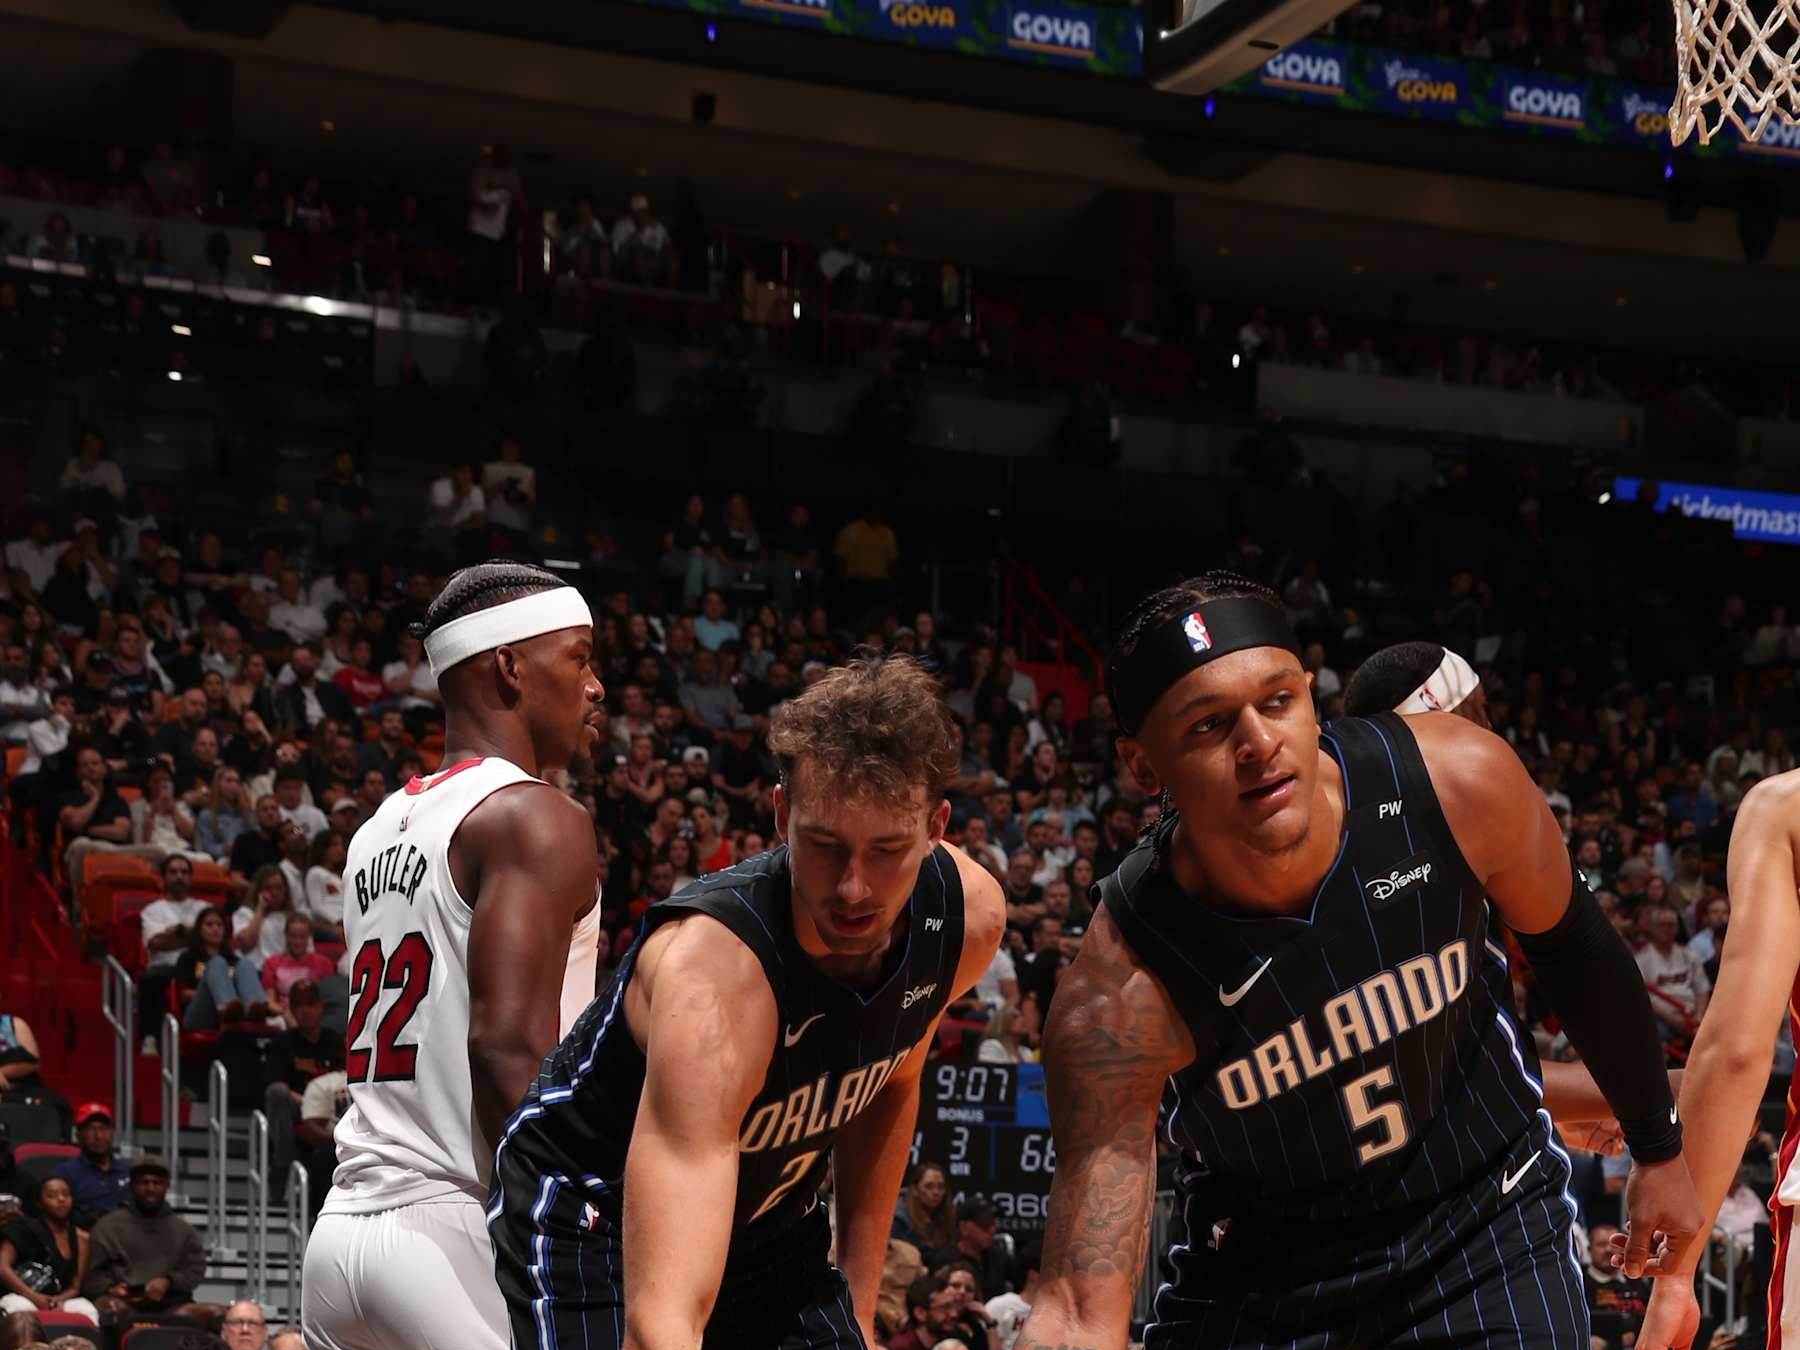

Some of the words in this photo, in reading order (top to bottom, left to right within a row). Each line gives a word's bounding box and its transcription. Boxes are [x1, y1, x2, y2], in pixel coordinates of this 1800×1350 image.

[1012, 11, 1091, 48] GOYA
[1508, 85, 1582, 119] GOYA
[1379, 799, 1403, 819] PW
[354, 842, 427, 917] BUTLER
[924, 917, 943, 932] PW
[346, 930, 435, 1084] 22
[1215, 936, 1471, 1111] ORLANDO
[936, 1065, 1009, 1102] 9:07
[936, 1106, 985, 1122] BONUS
[1341, 1064, 1411, 1166] 5
[949, 1125, 970, 1162] 3
